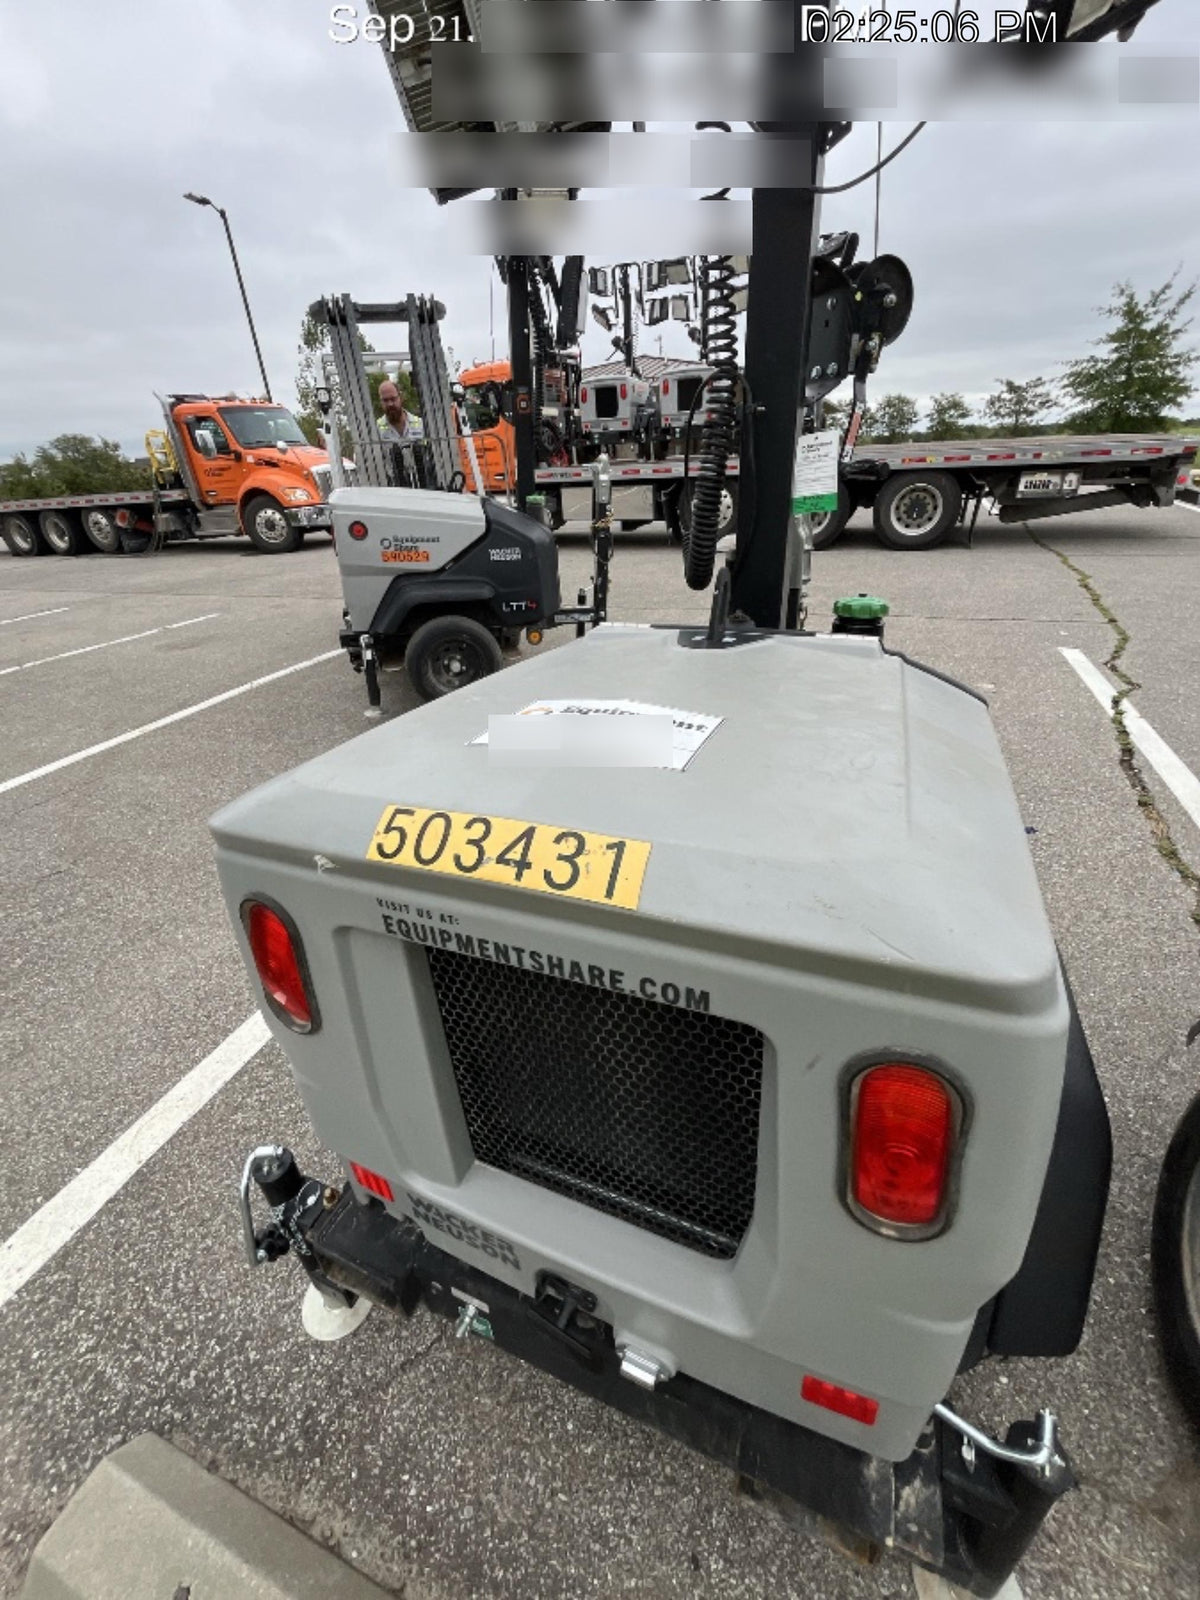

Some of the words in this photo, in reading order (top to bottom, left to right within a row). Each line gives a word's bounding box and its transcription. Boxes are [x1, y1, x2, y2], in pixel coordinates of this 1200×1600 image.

[375, 807, 628, 901] 503431
[376, 897, 410, 914] VISIT
[416, 907, 433, 919] US
[440, 913, 460, 925] AT:
[382, 913, 712, 1012] EQUIPMENTSHARE.COM
[406, 1192, 516, 1256] WACKER
[411, 1206, 522, 1271] NEUSON
